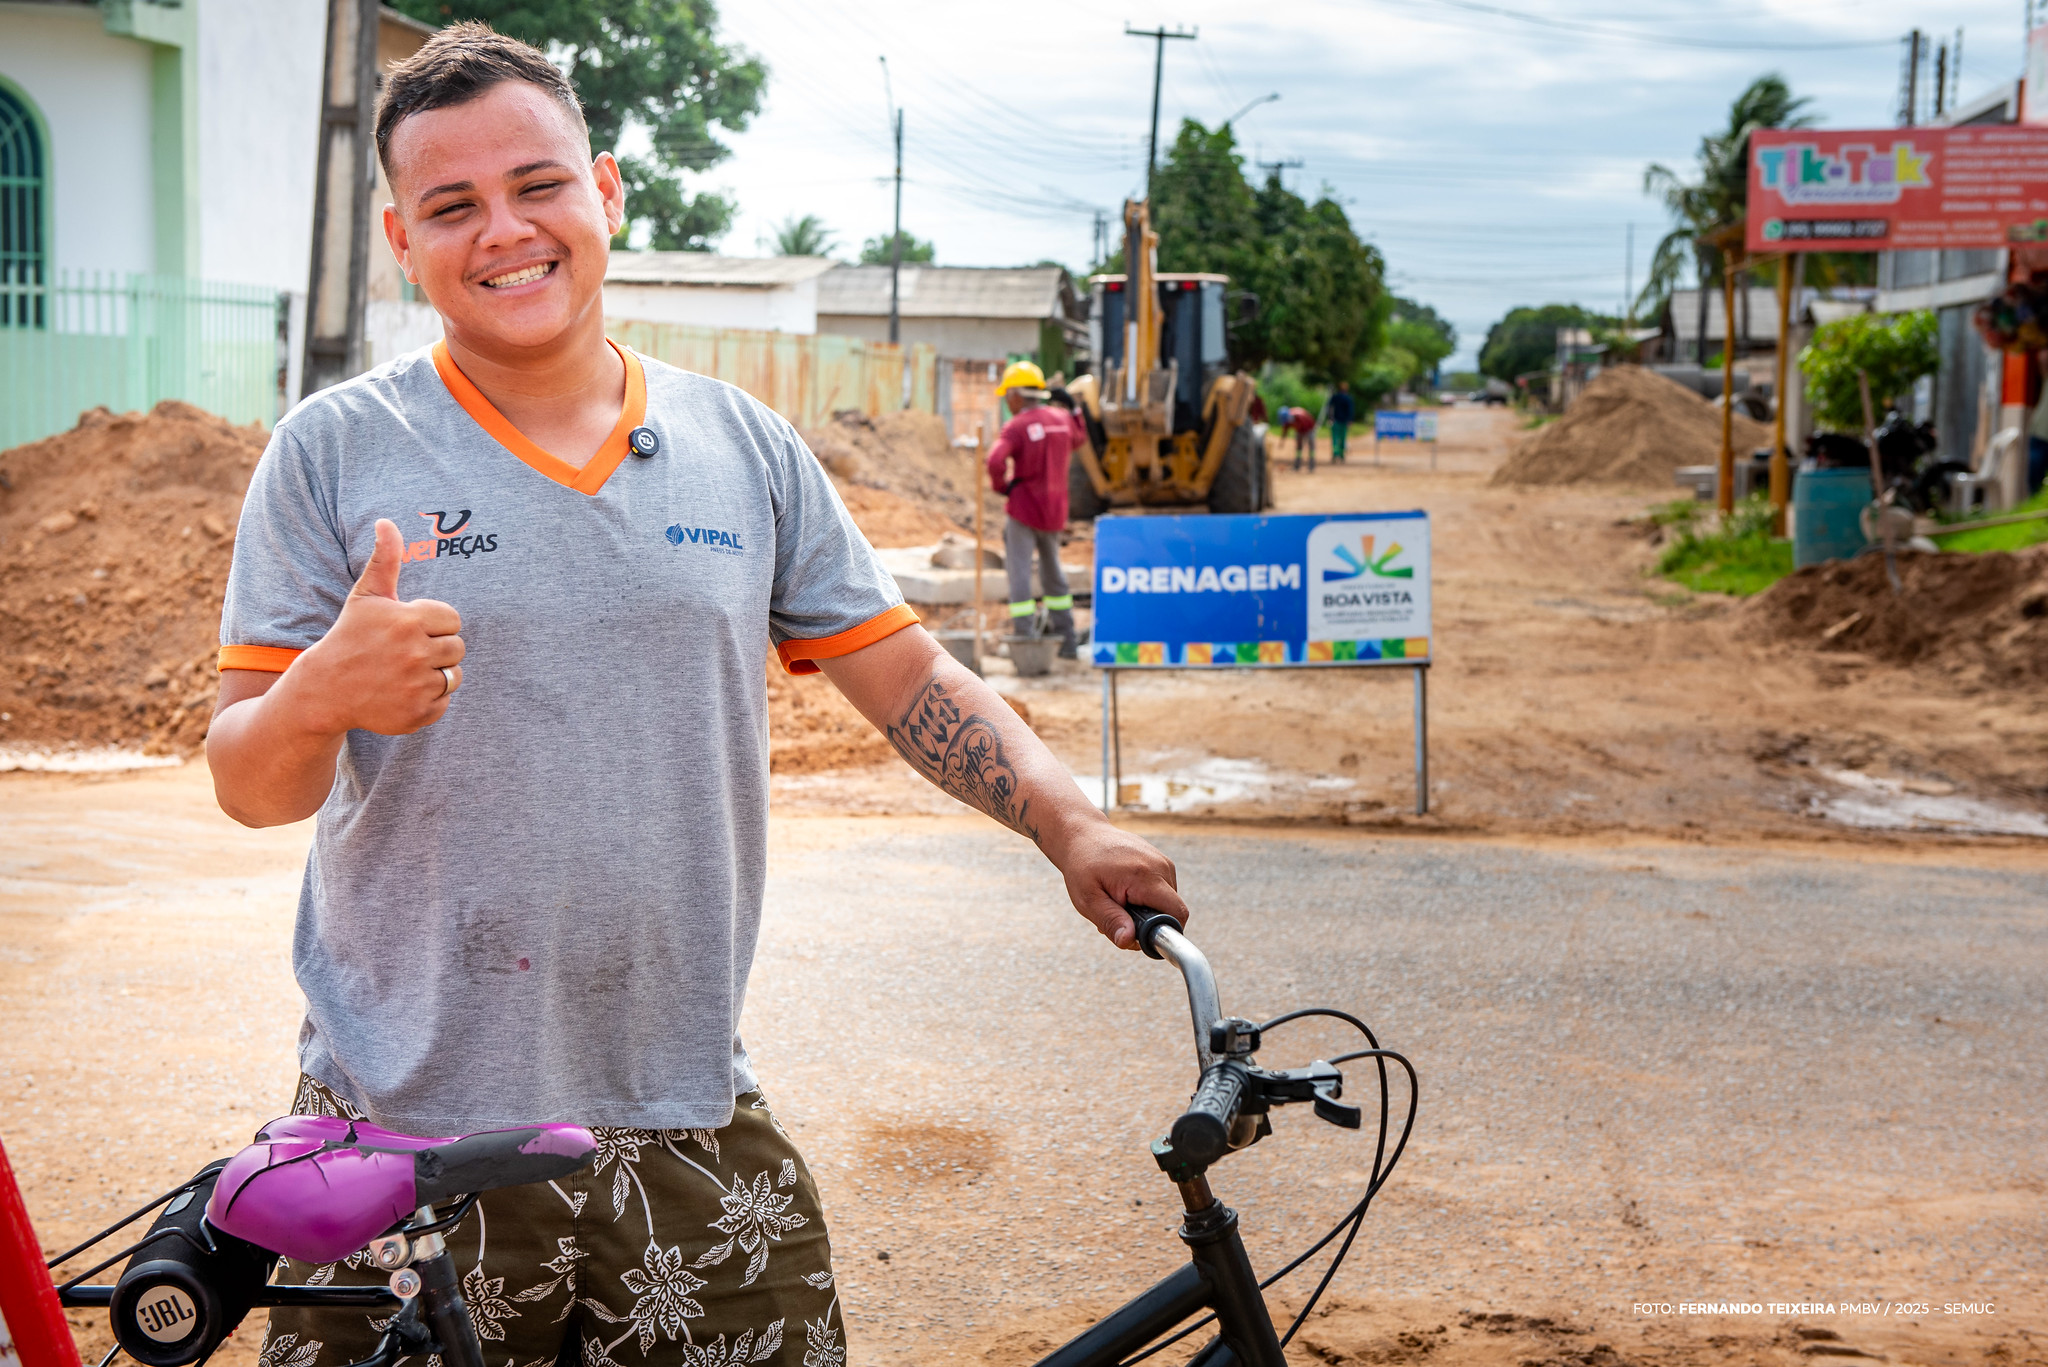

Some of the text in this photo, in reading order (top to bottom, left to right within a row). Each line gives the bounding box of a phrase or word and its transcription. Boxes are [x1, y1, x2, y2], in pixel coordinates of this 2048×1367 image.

[684, 527, 743, 550] VIPAL
[1101, 563, 1301, 594] DRENAGEM
[146, 1294, 195, 1333] JBL
